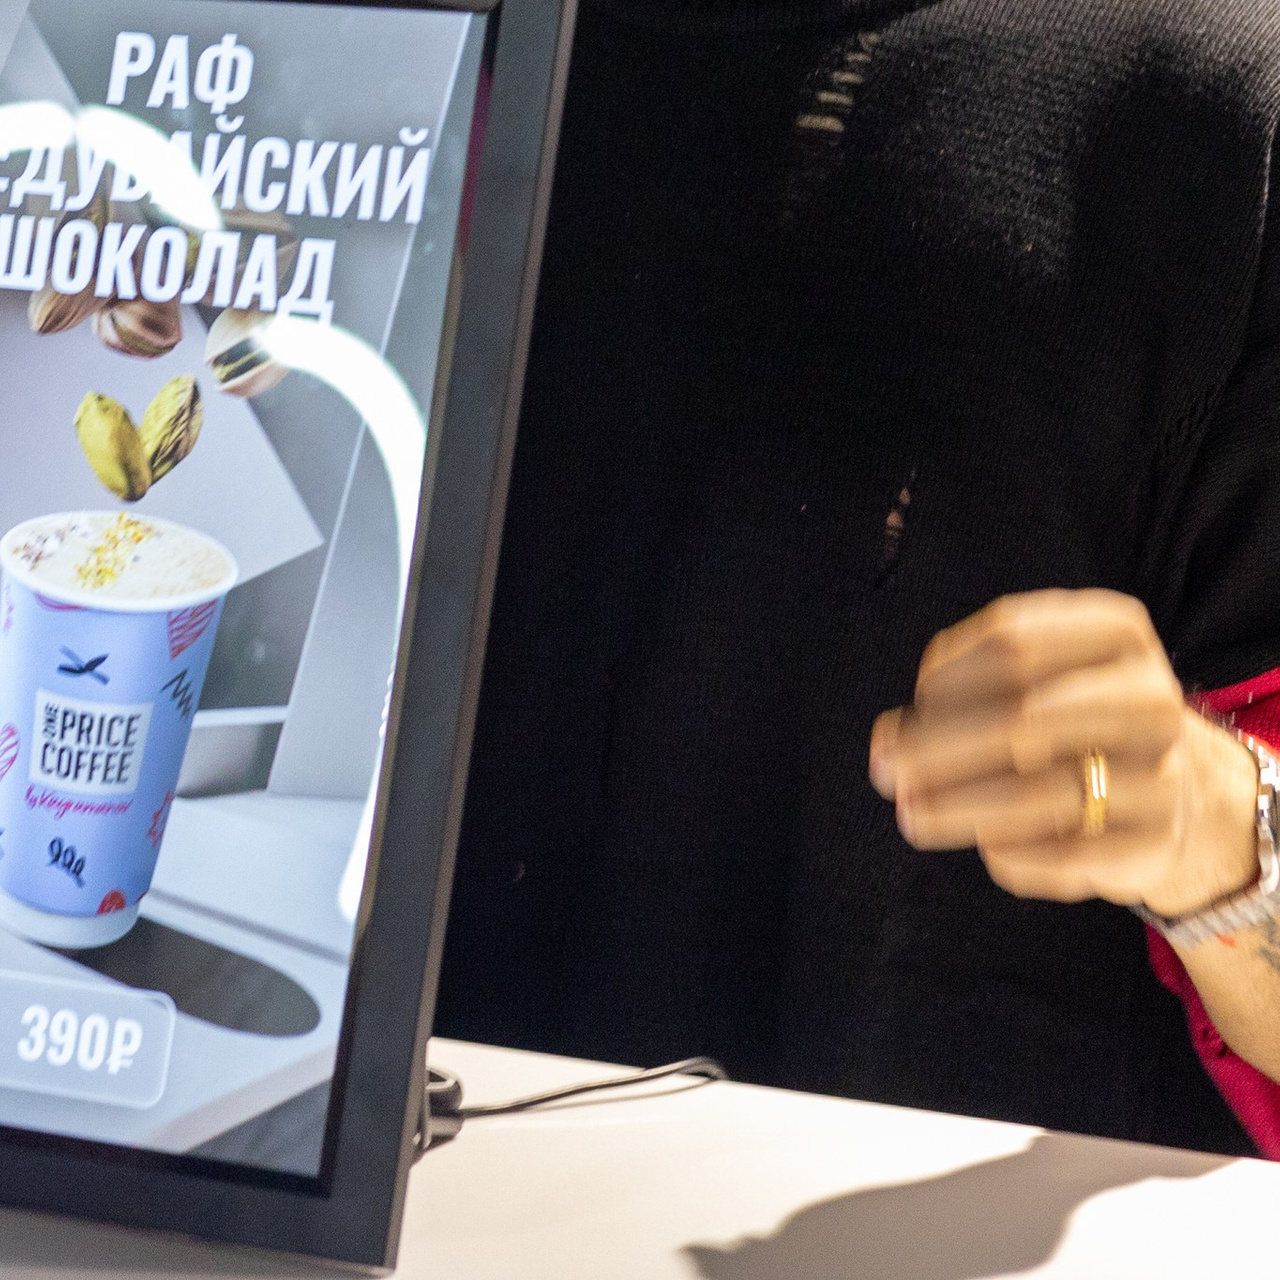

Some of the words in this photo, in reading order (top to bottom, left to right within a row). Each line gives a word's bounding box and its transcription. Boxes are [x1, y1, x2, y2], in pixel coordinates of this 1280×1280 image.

[107, 31, 255, 112] РАФ
[59, 708, 141, 747] PRICE
[41, 741, 134, 783] COFFEE
